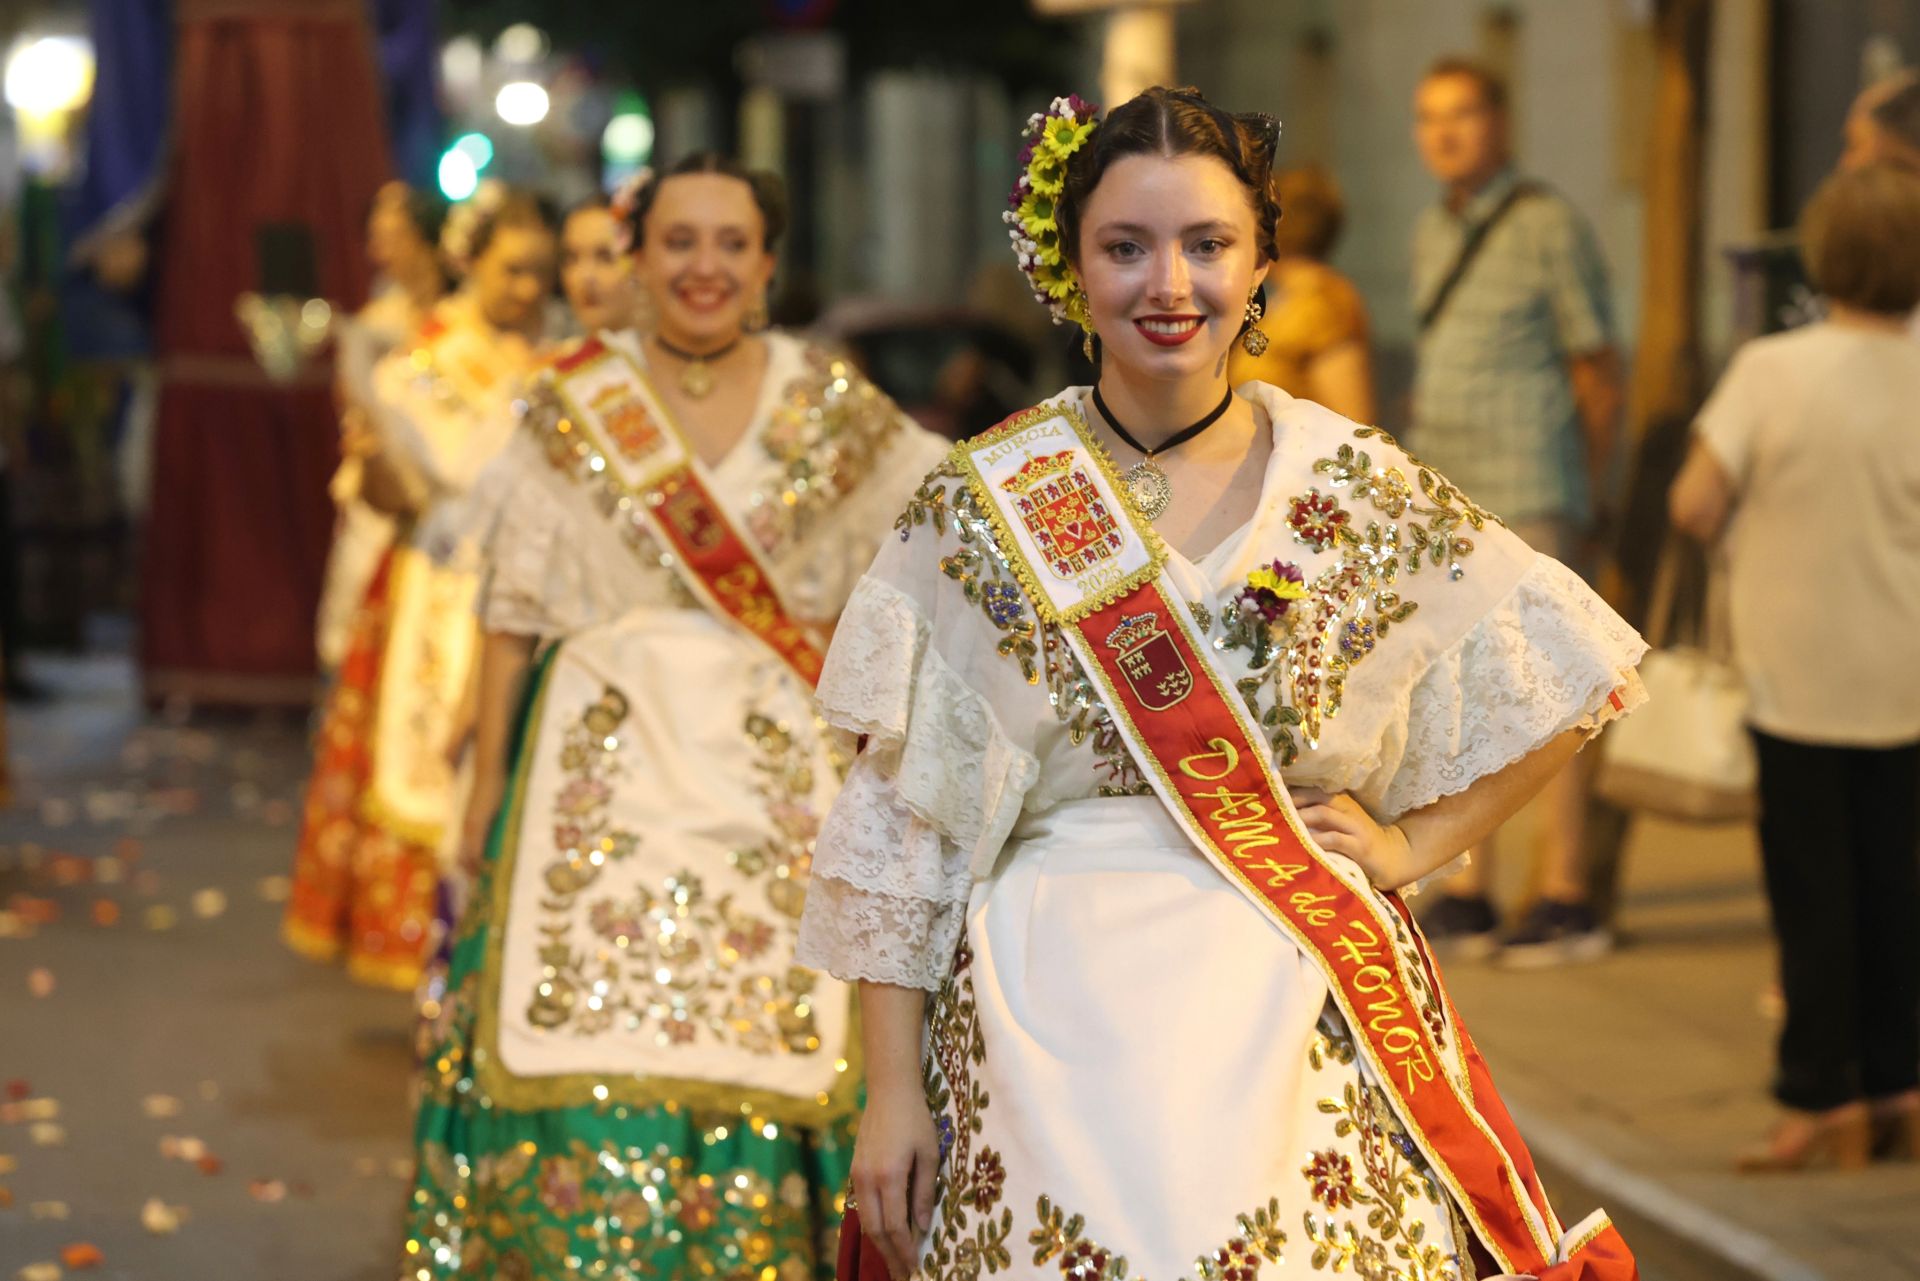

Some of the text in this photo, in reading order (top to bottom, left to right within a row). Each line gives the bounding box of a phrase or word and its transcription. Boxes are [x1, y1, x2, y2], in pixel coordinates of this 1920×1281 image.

[982, 424, 1063, 467] MURCIA
[1077, 562, 1125, 597] 2025
[1178, 737, 1435, 1095] DAMA de HONOR
